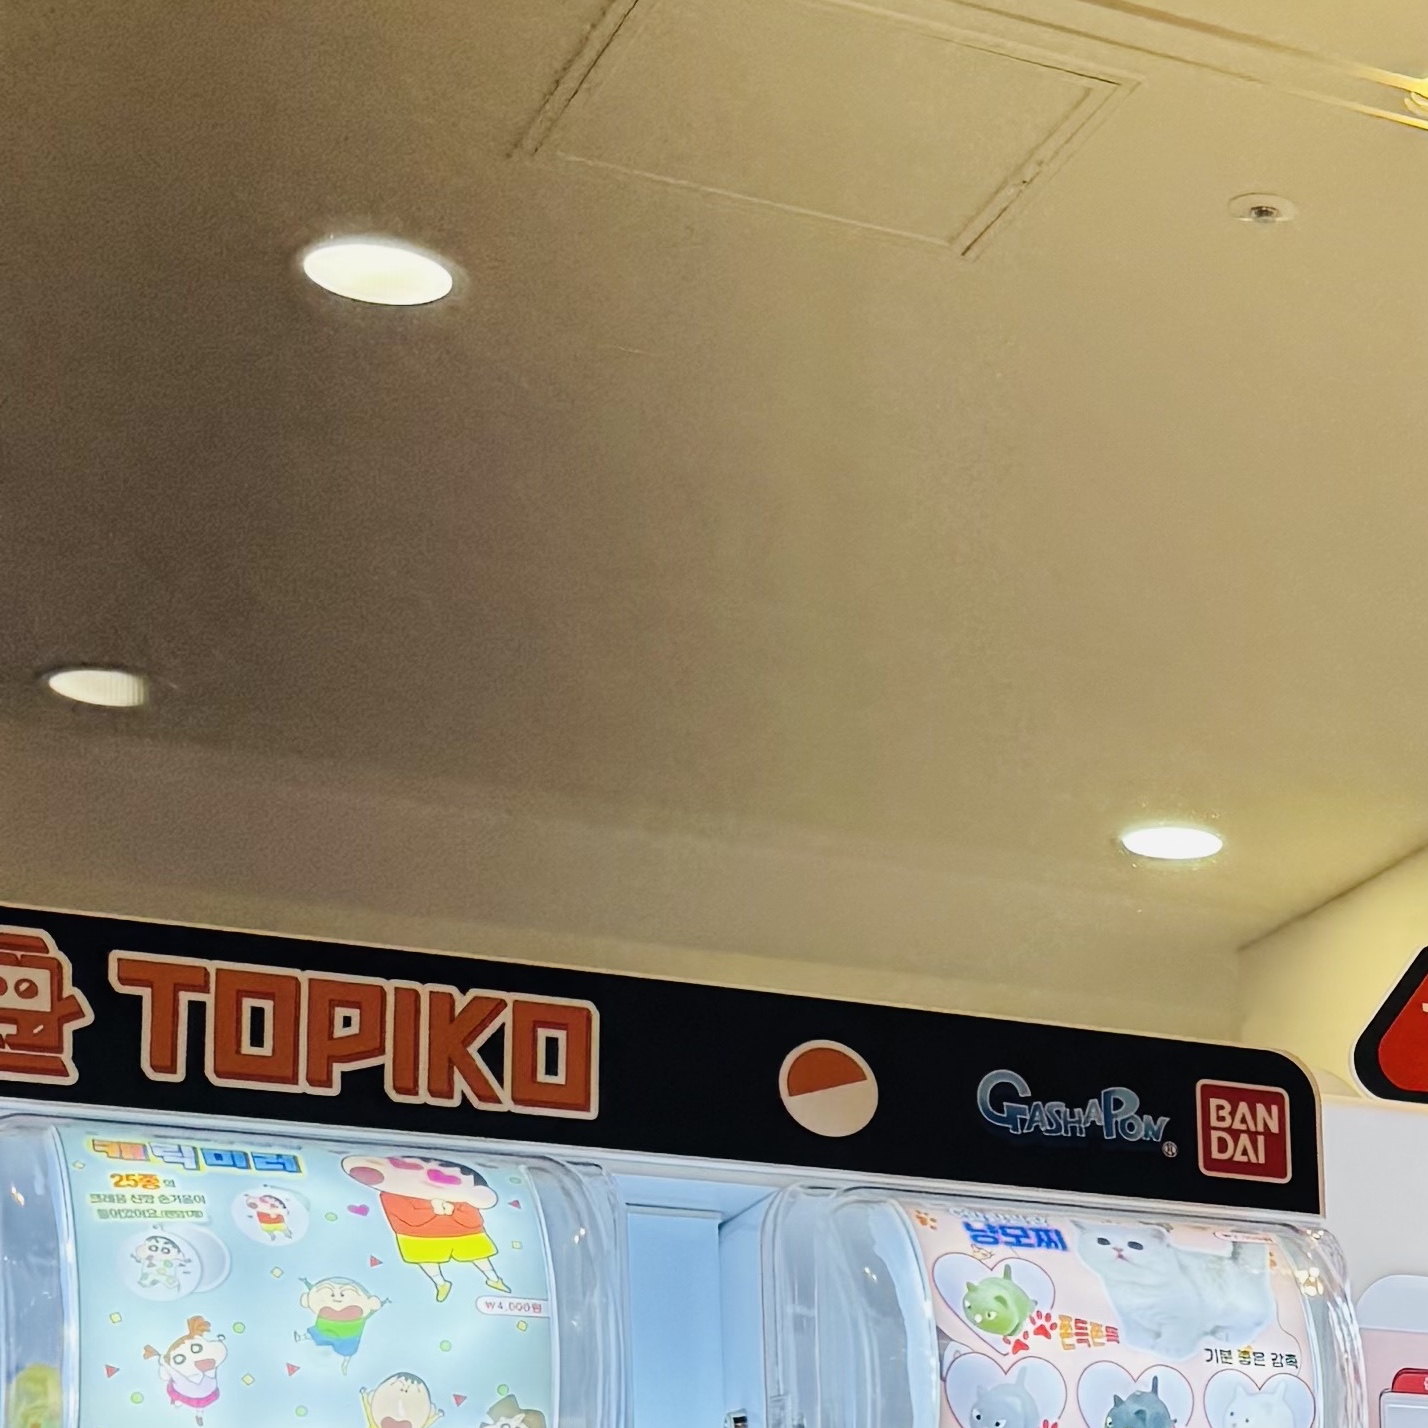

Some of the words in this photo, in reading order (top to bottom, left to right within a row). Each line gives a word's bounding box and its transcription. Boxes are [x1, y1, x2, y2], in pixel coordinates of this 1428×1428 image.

[108, 949, 600, 1121] TOPIKO
[1208, 1097, 1280, 1135] BAN
[1209, 1130, 1267, 1165] DAI
